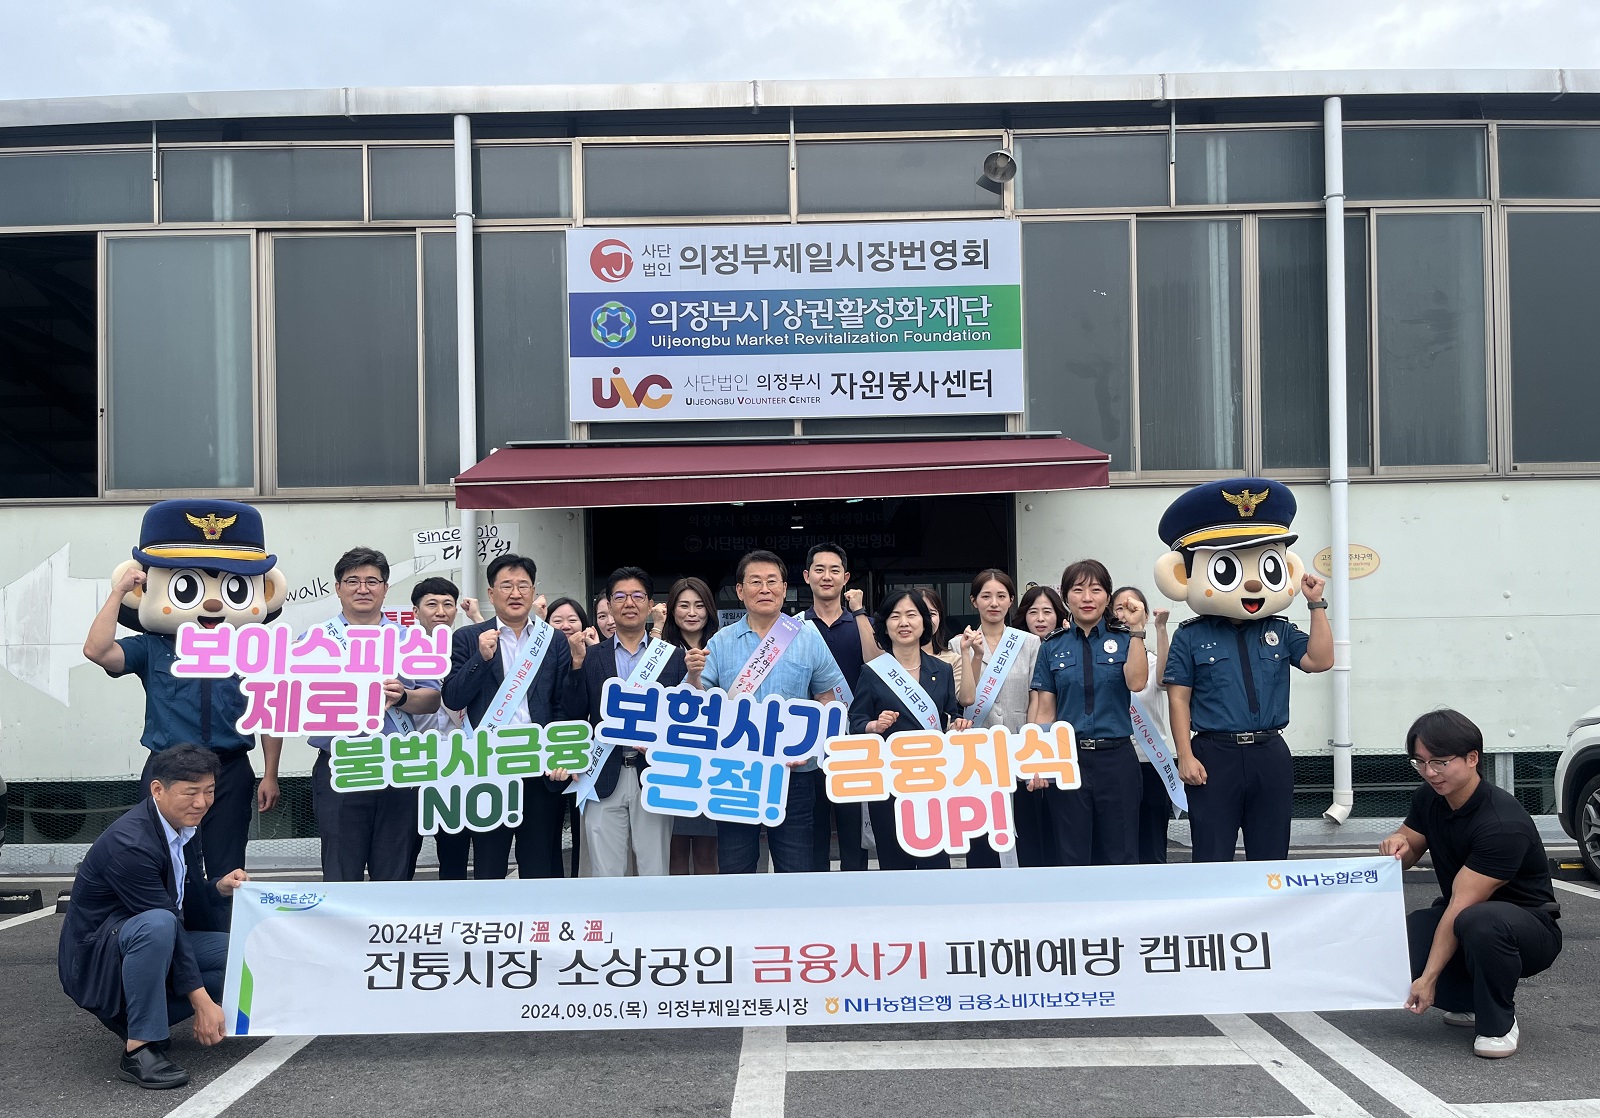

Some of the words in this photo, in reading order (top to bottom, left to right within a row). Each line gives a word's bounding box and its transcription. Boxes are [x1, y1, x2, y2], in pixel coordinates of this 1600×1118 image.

[641, 244, 672, 259] 사단
[642, 262, 672, 278] 법인
[679, 238, 990, 276] 의정부제일시장번영회
[651, 334, 731, 349] Uijeongbu
[736, 333, 789, 346] Market
[795, 331, 898, 344] Revitalization
[904, 328, 991, 342] Foundation
[683, 374, 749, 393] 사단법인
[756, 372, 821, 391] 의정부시
[830, 368, 993, 402] 자원봉사센터
[789, 395, 821, 404] CENTER
[417, 528, 461, 543] since
[176, 626, 448, 675] 보이스피싱
[529, 620, 549, 658] 이스피싱
[639, 641, 668, 681] 보이스피싱
[241, 679, 382, 733] 제로!
[600, 683, 842, 760] 보험사기
[333, 723, 591, 789] 불법사금융
[828, 726, 1076, 798] 금융지식
[423, 779, 519, 831] NO!
[646, 751, 784, 821] 근절!
[900, 790, 1009, 851] UP!
[1285, 868, 1378, 888] NH농협은행
[282, 893, 298, 905] 모든
[299, 892, 318, 904] 순간
[368, 922, 443, 945] 2024년
[558, 921, 576, 942] &
[363, 948, 543, 991] 전통시장
[558, 945, 734, 987] 소상공인
[752, 942, 928, 985] 금융사기
[945, 936, 1125, 979] 피해예방
[1139, 931, 1272, 972] 캠페인
[521, 999, 648, 1021] 2024.09.05.(목)
[657, 996, 808, 1019] 의정부제일전통시장
[844, 994, 952, 1014] NH농협은행
[958, 989, 1116, 1012] 금융소비자보호부문
